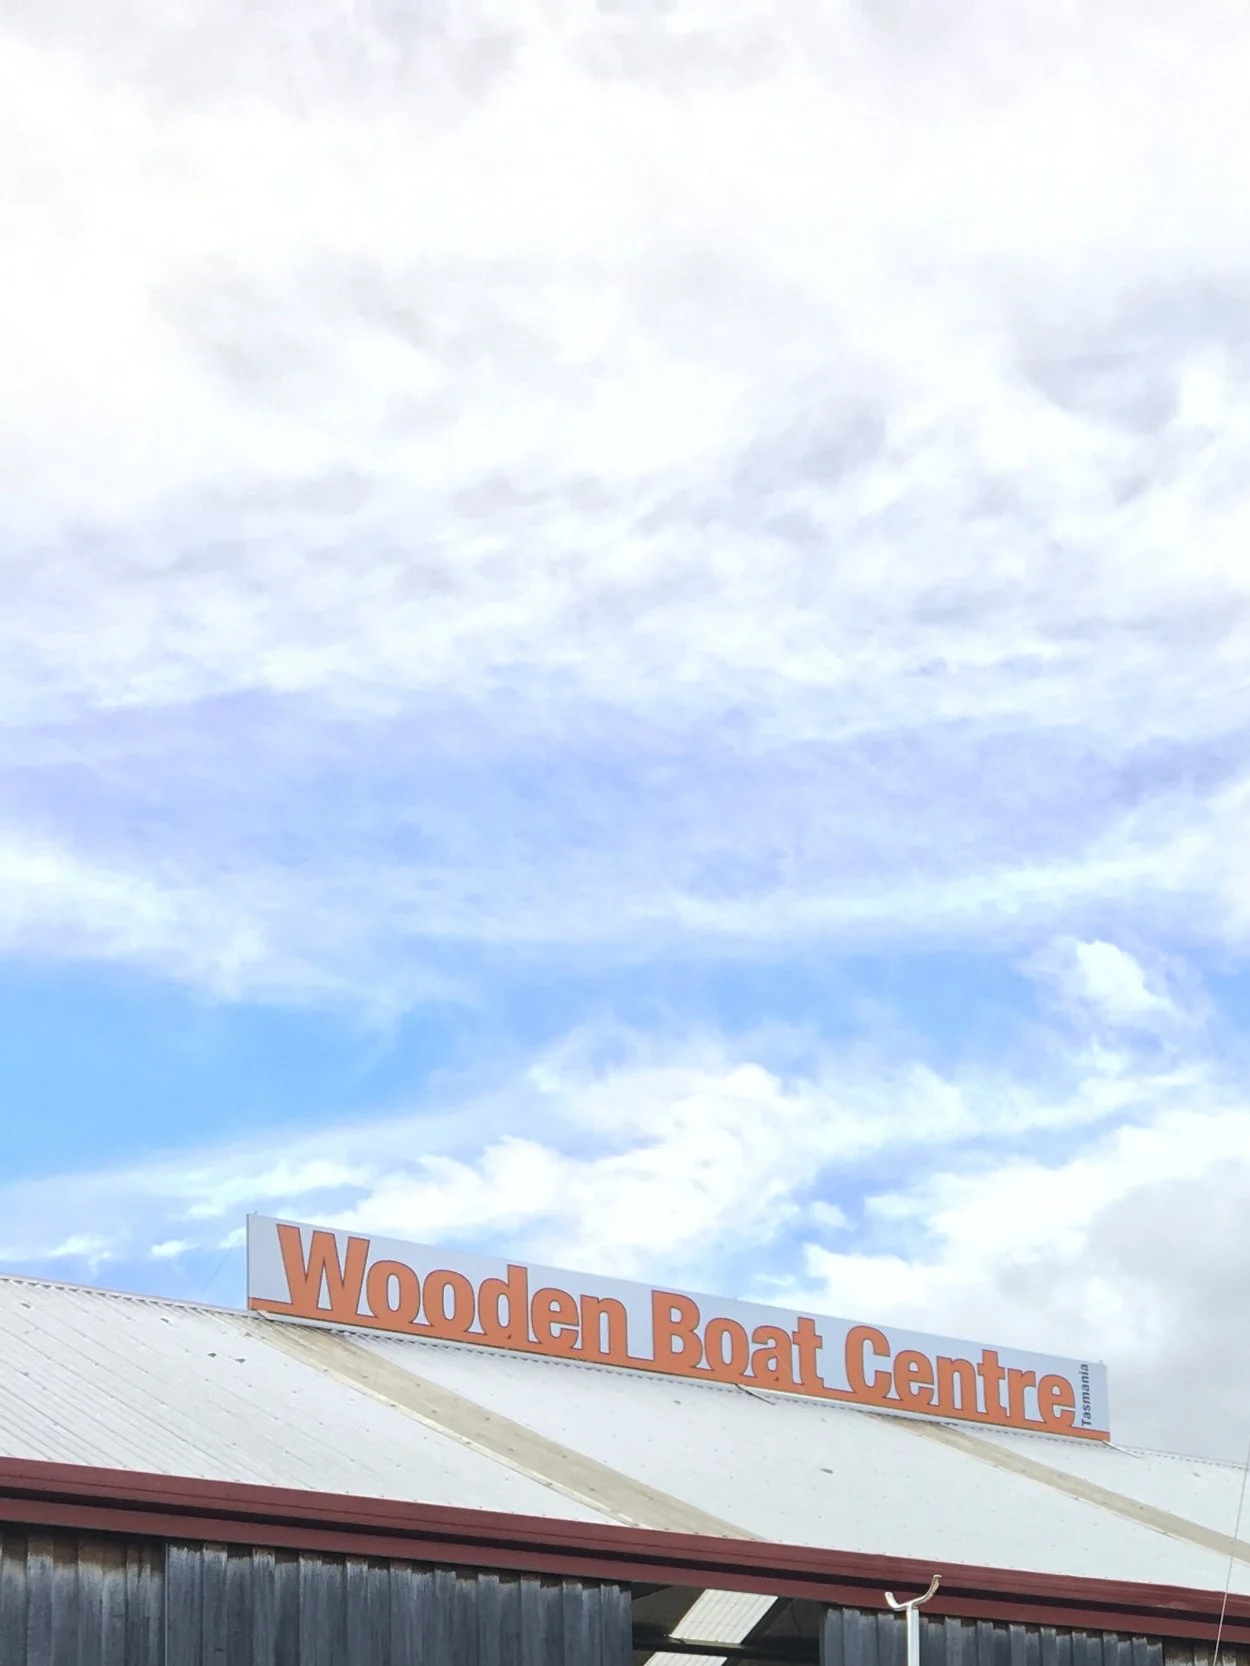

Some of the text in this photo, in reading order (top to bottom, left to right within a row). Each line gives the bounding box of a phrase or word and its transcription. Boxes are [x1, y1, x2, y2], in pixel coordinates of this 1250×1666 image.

[276, 1223, 1076, 1428] Wooden Boat Centre
[1079, 1363, 1092, 1427] Tasmania
